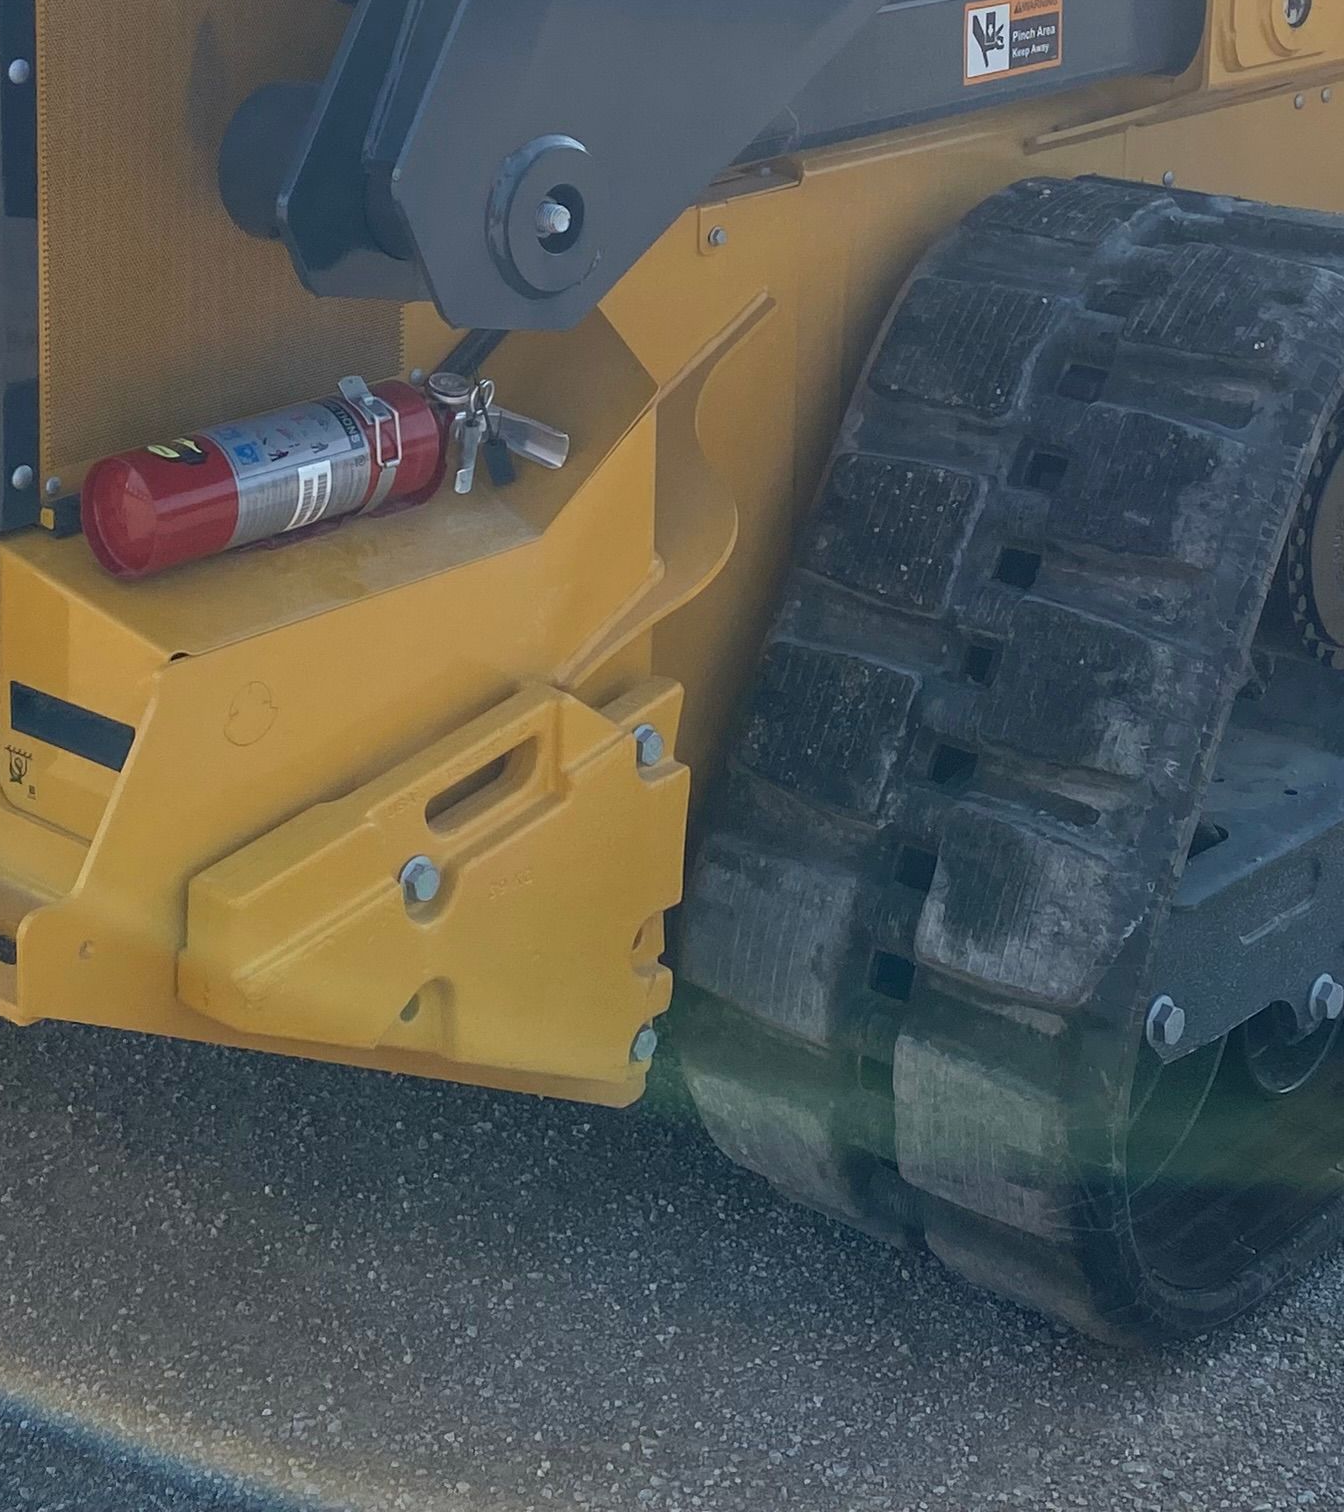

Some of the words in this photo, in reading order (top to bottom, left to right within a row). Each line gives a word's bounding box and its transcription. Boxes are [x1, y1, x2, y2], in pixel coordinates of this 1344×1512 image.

[1012, 28, 1036, 42] Pinch
[1036, 25, 1056, 37] Area
[1011, 47, 1030, 58] Keep
[1030, 43, 1050, 54] Away
